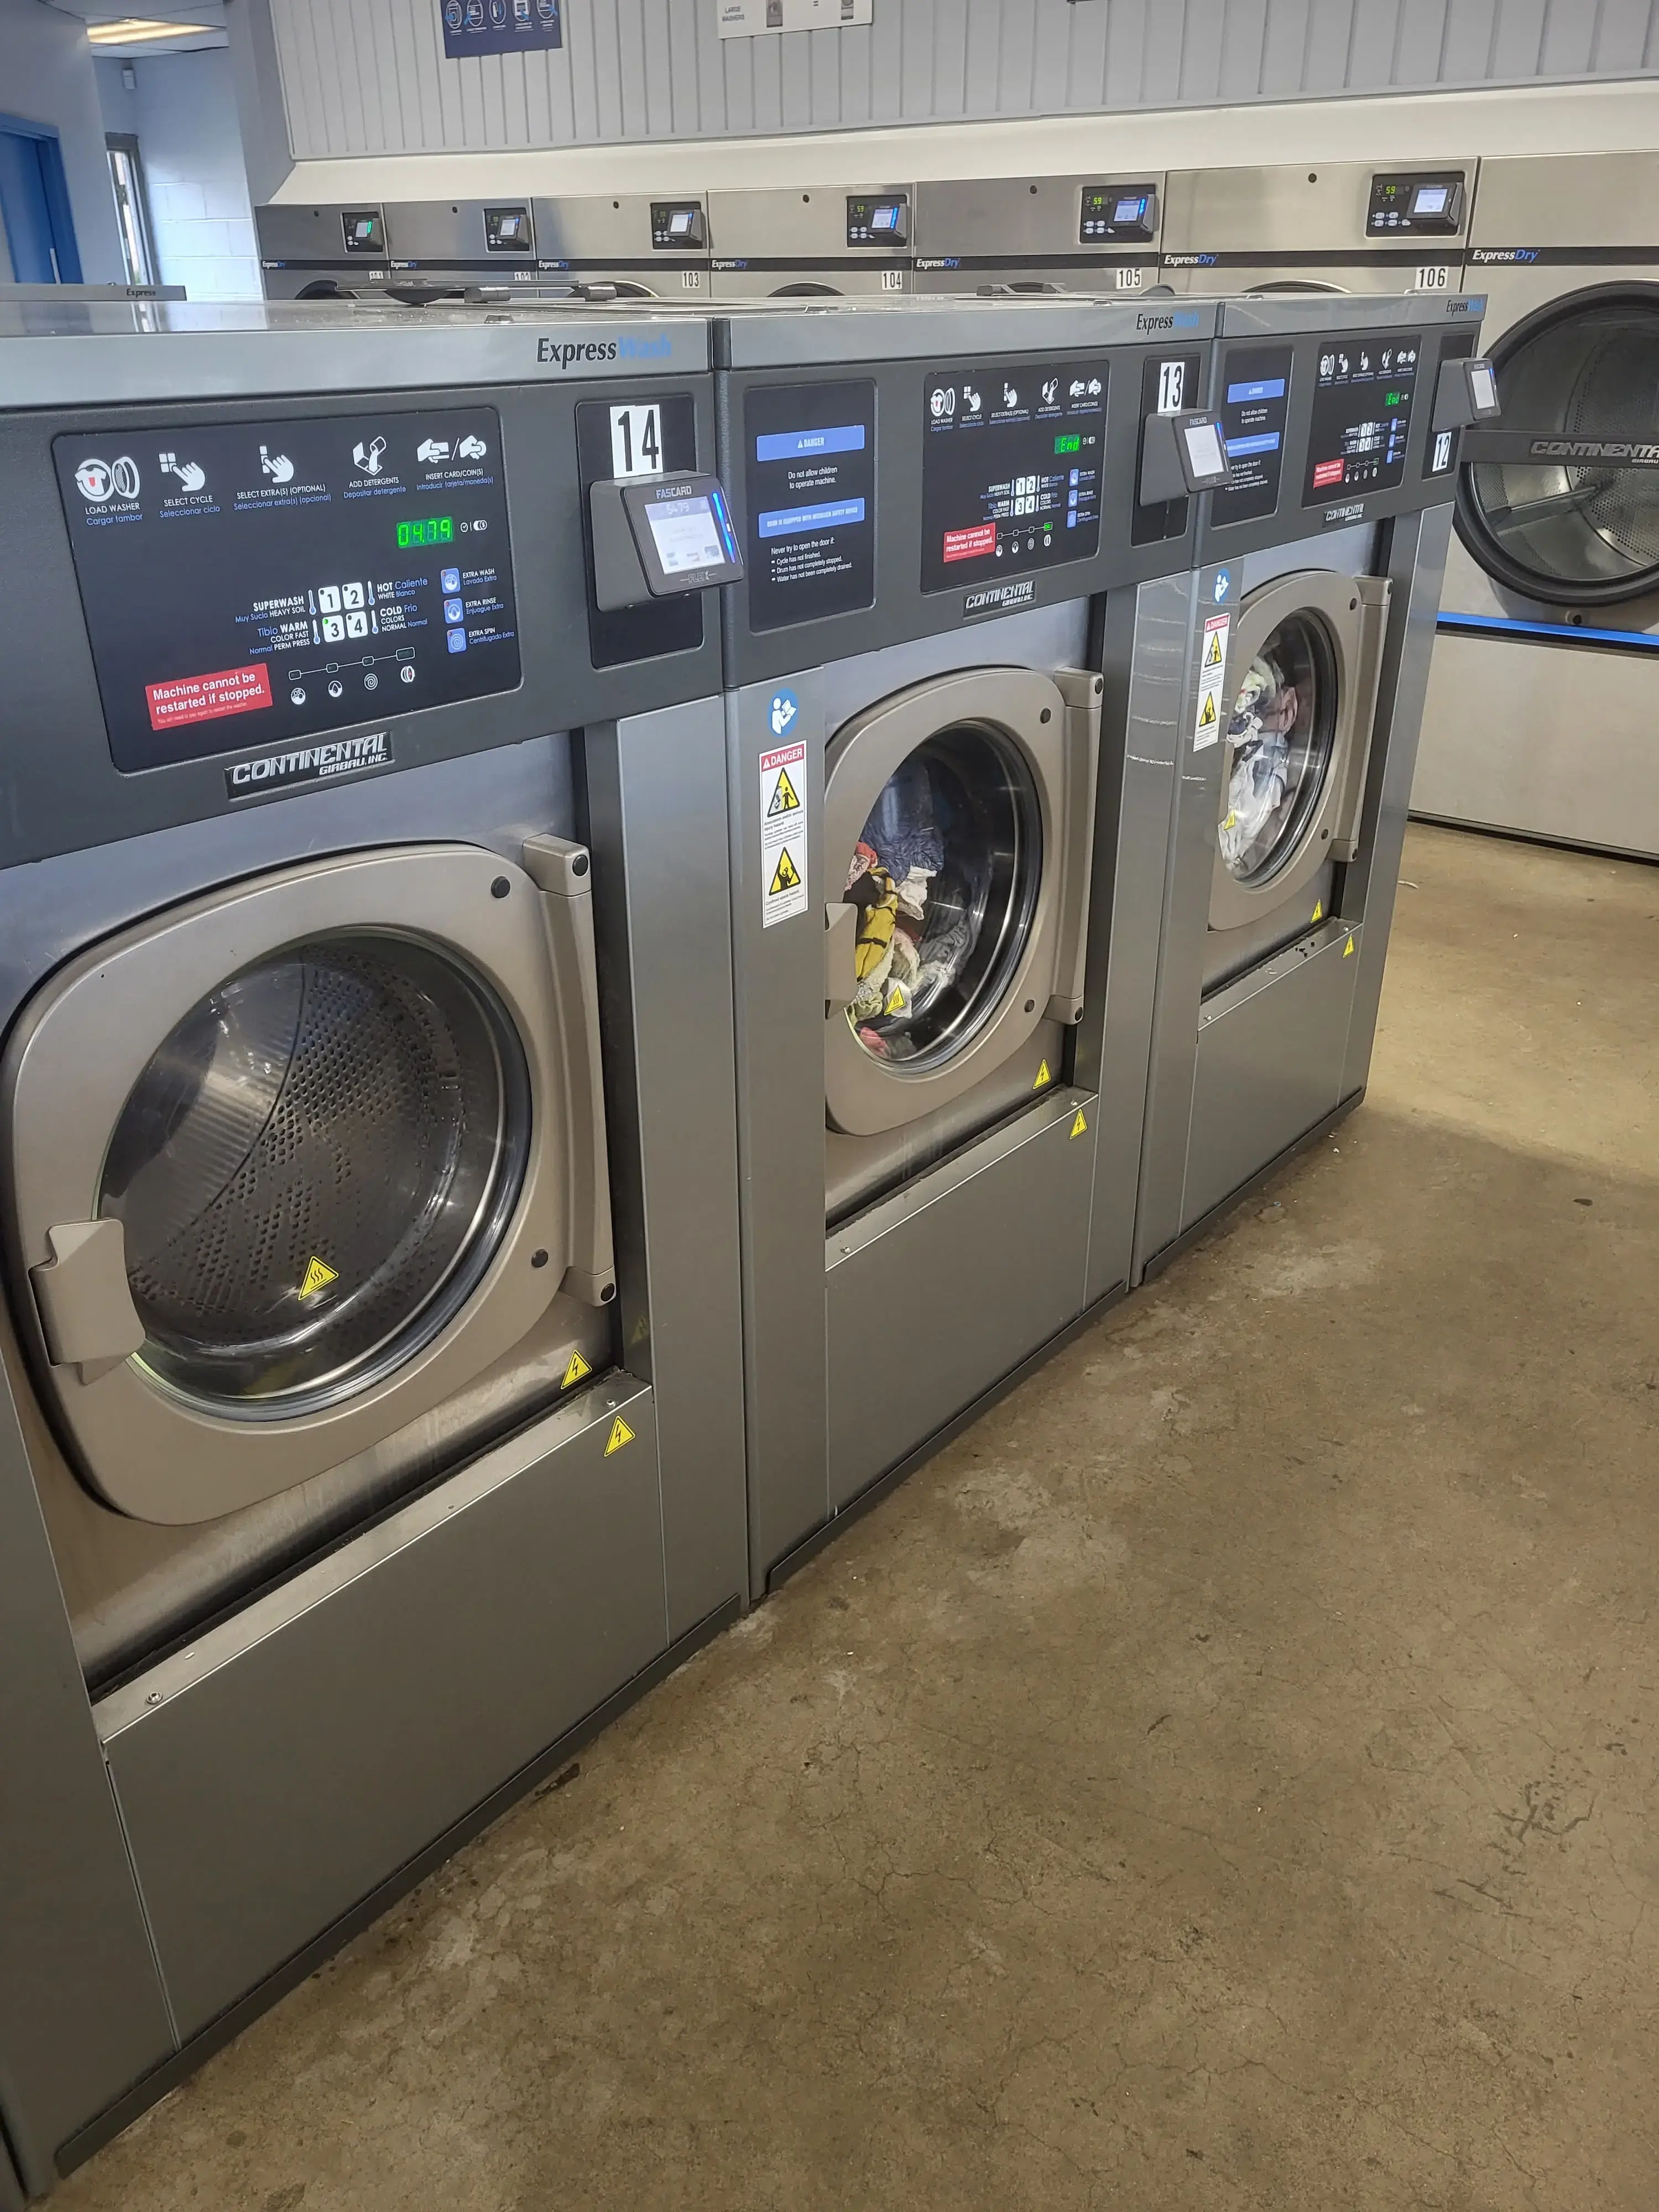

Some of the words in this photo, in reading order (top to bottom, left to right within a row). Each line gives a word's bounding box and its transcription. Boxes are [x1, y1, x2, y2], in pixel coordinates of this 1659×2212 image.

[1386, 186, 1396, 194] 59
[1164, 254, 1217, 266] ExpressDry
[1472, 249, 1538, 263] ExpressDry
[539, 260, 568, 270] ExpressDry
[711, 258, 747, 270] ExpressDry
[916, 257, 961, 270] ExpressDry
[684, 272, 699, 286] 103
[883, 272, 901, 288] 104
[1119, 269, 1140, 286] 105
[1419, 267, 1446, 288] 106
[1447, 298, 1483, 316] ExpressWash
[1136, 311, 1198, 335] ExpressWash
[537, 332, 672, 370] ExpressWash
[1163, 365, 1182, 409] 13
[617, 409, 659, 472] 14
[804, 437, 825, 447] DANGER
[1060, 436, 1080, 452] End
[1437, 435, 1450, 468] 12
[425, 472, 443, 481] INSERT
[444, 468, 484, 479] CARD/COIN(S)
[787, 471, 795, 479] Do
[796, 470, 805, 479] not
[805, 468, 818, 477] allow
[818, 466, 838, 476] children
[348, 480, 363, 489] ADD
[363, 476, 399, 487] DETERGENTS
[416, 481, 443, 491] Introducir
[445, 477, 494, 489] tarjeta/moneda(s)
[789, 481, 795, 489] to
[795, 479, 814, 490] operate
[815, 476, 837, 486] machine.
[988, 483, 1010, 492] SUPERWASH
[1029, 480, 1034, 491] 2
[237, 489, 260, 500] SELECT
[260, 487, 289, 498] EXTRA(S)
[289, 483, 326, 495] (OPTIONAL)
[343, 488, 374, 500] Depositar
[374, 486, 407, 498] detergente
[656, 486, 692, 499] FASCARD
[164, 498, 189, 507] SELECT
[190, 495, 214, 505] CYCLE
[233, 499, 273, 510] Seleccionar
[274, 496, 299, 508] extra(s)
[299, 494, 332, 506] (opcional)
[1018, 502, 1022, 512] 3
[1028, 500, 1032, 510] 4
[85, 505, 107, 515] LOAD
[108, 502, 140, 513] WASHER
[159, 508, 201, 518] Seleccionar
[201, 505, 221, 514] ciclo
[86, 516, 114, 526] Cargar
[115, 513, 143, 523] tambor
[398, 519, 451, 547] 04.79
[946, 534, 967, 542] Machine
[967, 530, 983, 539] cannot
[771, 546, 785, 555] Never
[799, 542, 811, 551] open
[819, 538, 830, 546] door
[946, 541, 968, 552] restarted
[973, 536, 993, 547] stopped.
[776, 557, 789, 566] Cycle
[776, 566, 789, 574] Drum
[804, 559, 826, 569] completely
[462, 570, 479, 579] EXTRA
[479, 568, 495, 576] WASH
[776, 574, 790, 583] Water
[805, 569, 816, 577] been
[816, 565, 837, 575] completely
[377, 582, 393, 593] HOT
[395, 577, 428, 590] Caliente
[463, 577, 483, 586] Lavado
[326, 593, 334, 608] 1
[349, 589, 359, 605] 2
[378, 591, 395, 600] WHITE
[396, 588, 415, 597] Blanco
[966, 581, 1034, 609] CONTINENTAL
[253, 595, 305, 612] SUPERWASH
[465, 600, 482, 608] EXTRA
[482, 597, 497, 606] RINSE
[235, 615, 249, 624] Muy
[250, 611, 268, 620] Sucio
[269, 608, 291, 618] HEAVY
[291, 605, 306, 614] SOIL
[380, 606, 403, 617] COLD
[404, 604, 418, 613] Frio
[466, 606, 491, 615] Enjuague
[354, 619, 363, 633] 4
[380, 614, 405, 624] COLORS
[382, 622, 407, 632] NORMAL
[408, 618, 428, 628] Normal
[257, 626, 278, 638] Tibio
[279, 620, 308, 633] WARM
[331, 623, 340, 638] 3
[468, 629, 483, 638] EXTRA
[484, 627, 496, 635] SPIN
[270, 633, 291, 643] COLOR
[292, 630, 309, 640] FAST
[249, 644, 273, 655] Normal
[274, 641, 291, 651] PERM
[292, 638, 310, 648] PRESS
[153, 684, 200, 701] Machine
[202, 674, 240, 691] cannot
[242, 672, 255, 684] be
[155, 695, 206, 715] restarted
[208, 692, 216, 703] if
[218, 684, 265, 702] stopped.
[233, 734, 387, 785] CONTINENTAL
[770, 748, 802, 766] DANGER
